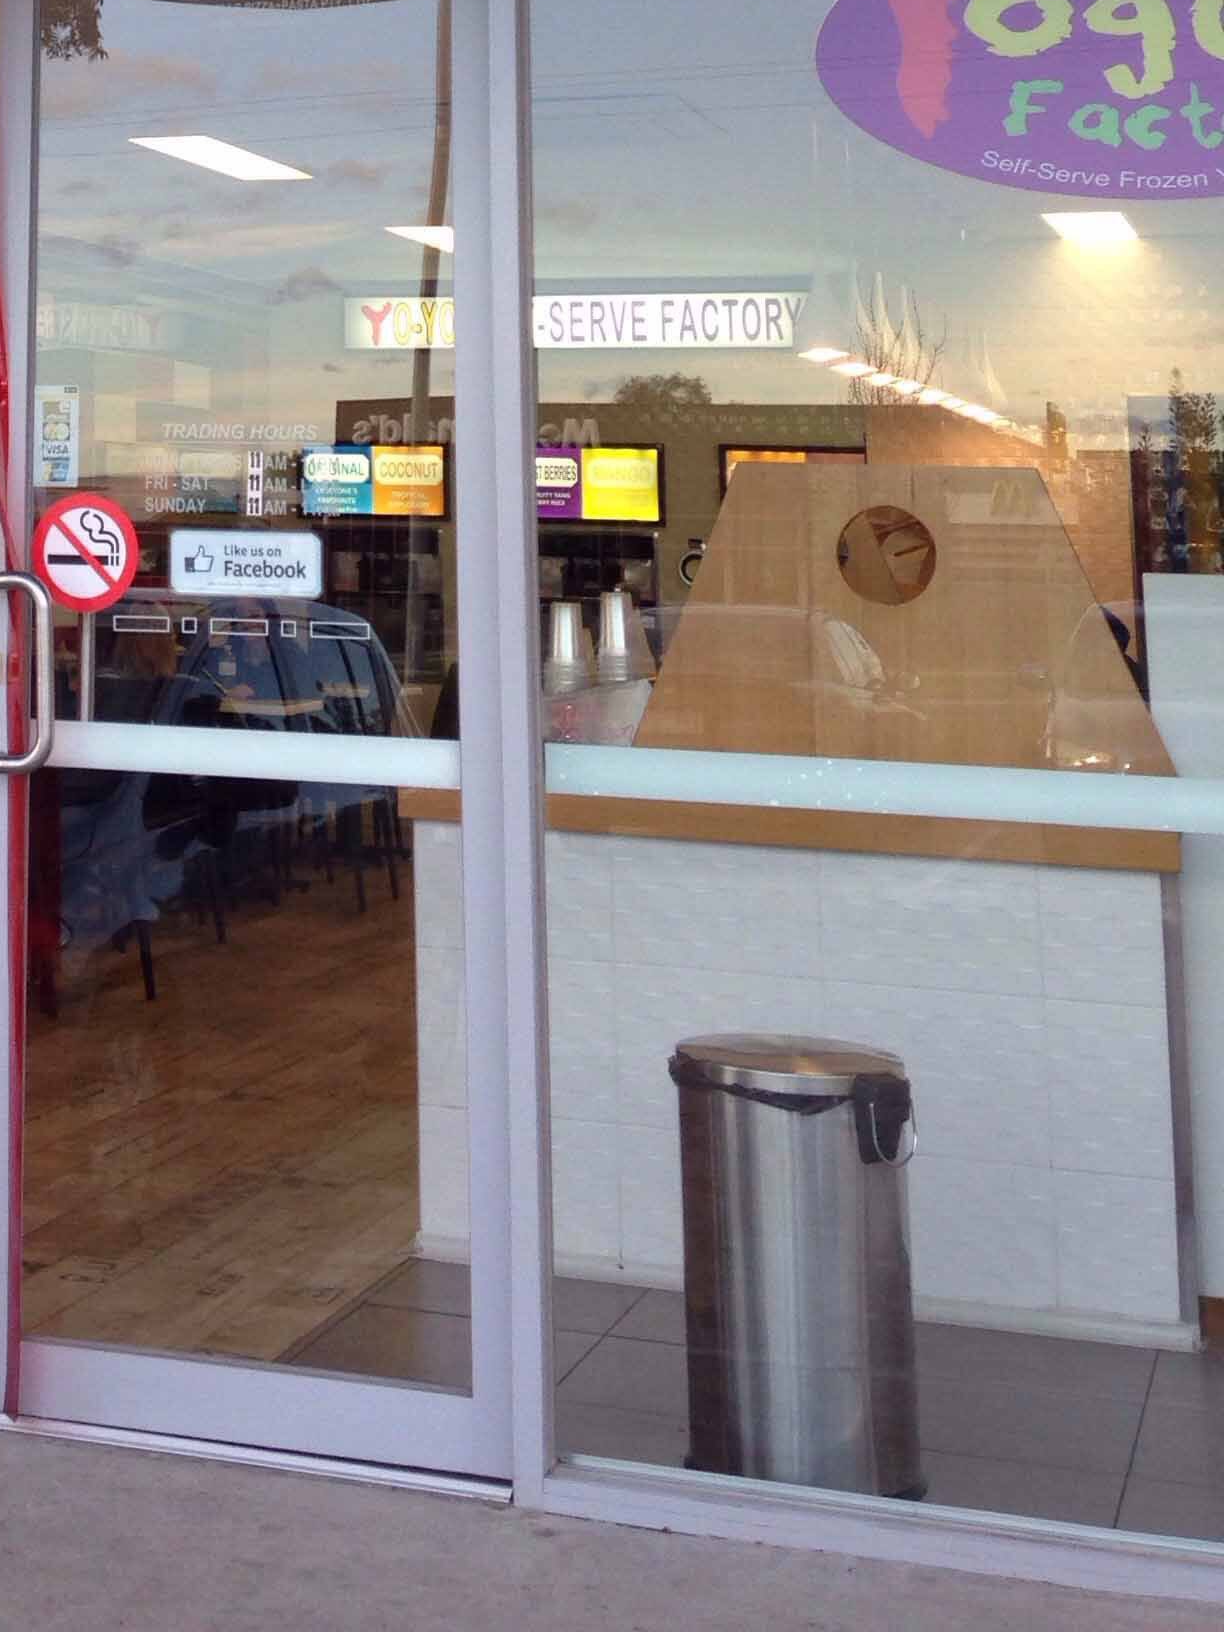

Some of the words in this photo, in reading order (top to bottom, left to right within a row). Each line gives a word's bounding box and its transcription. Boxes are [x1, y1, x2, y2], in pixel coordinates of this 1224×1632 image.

[1002, 79, 1224, 150] Fact
[1119, 168, 1209, 190] Frozen
[661, 296, 801, 344] FACTORY
[162, 423, 244, 440] TRADING
[249, 423, 319, 441] HOURS
[380, 461, 438, 478] COCONUT
[181, 476, 210, 491] SAT
[144, 497, 207, 514] SUNDAY
[224, 544, 248, 556] Like
[251, 547, 264, 557] us
[267, 547, 282, 557] on
[224, 560, 307, 579] Facebook
